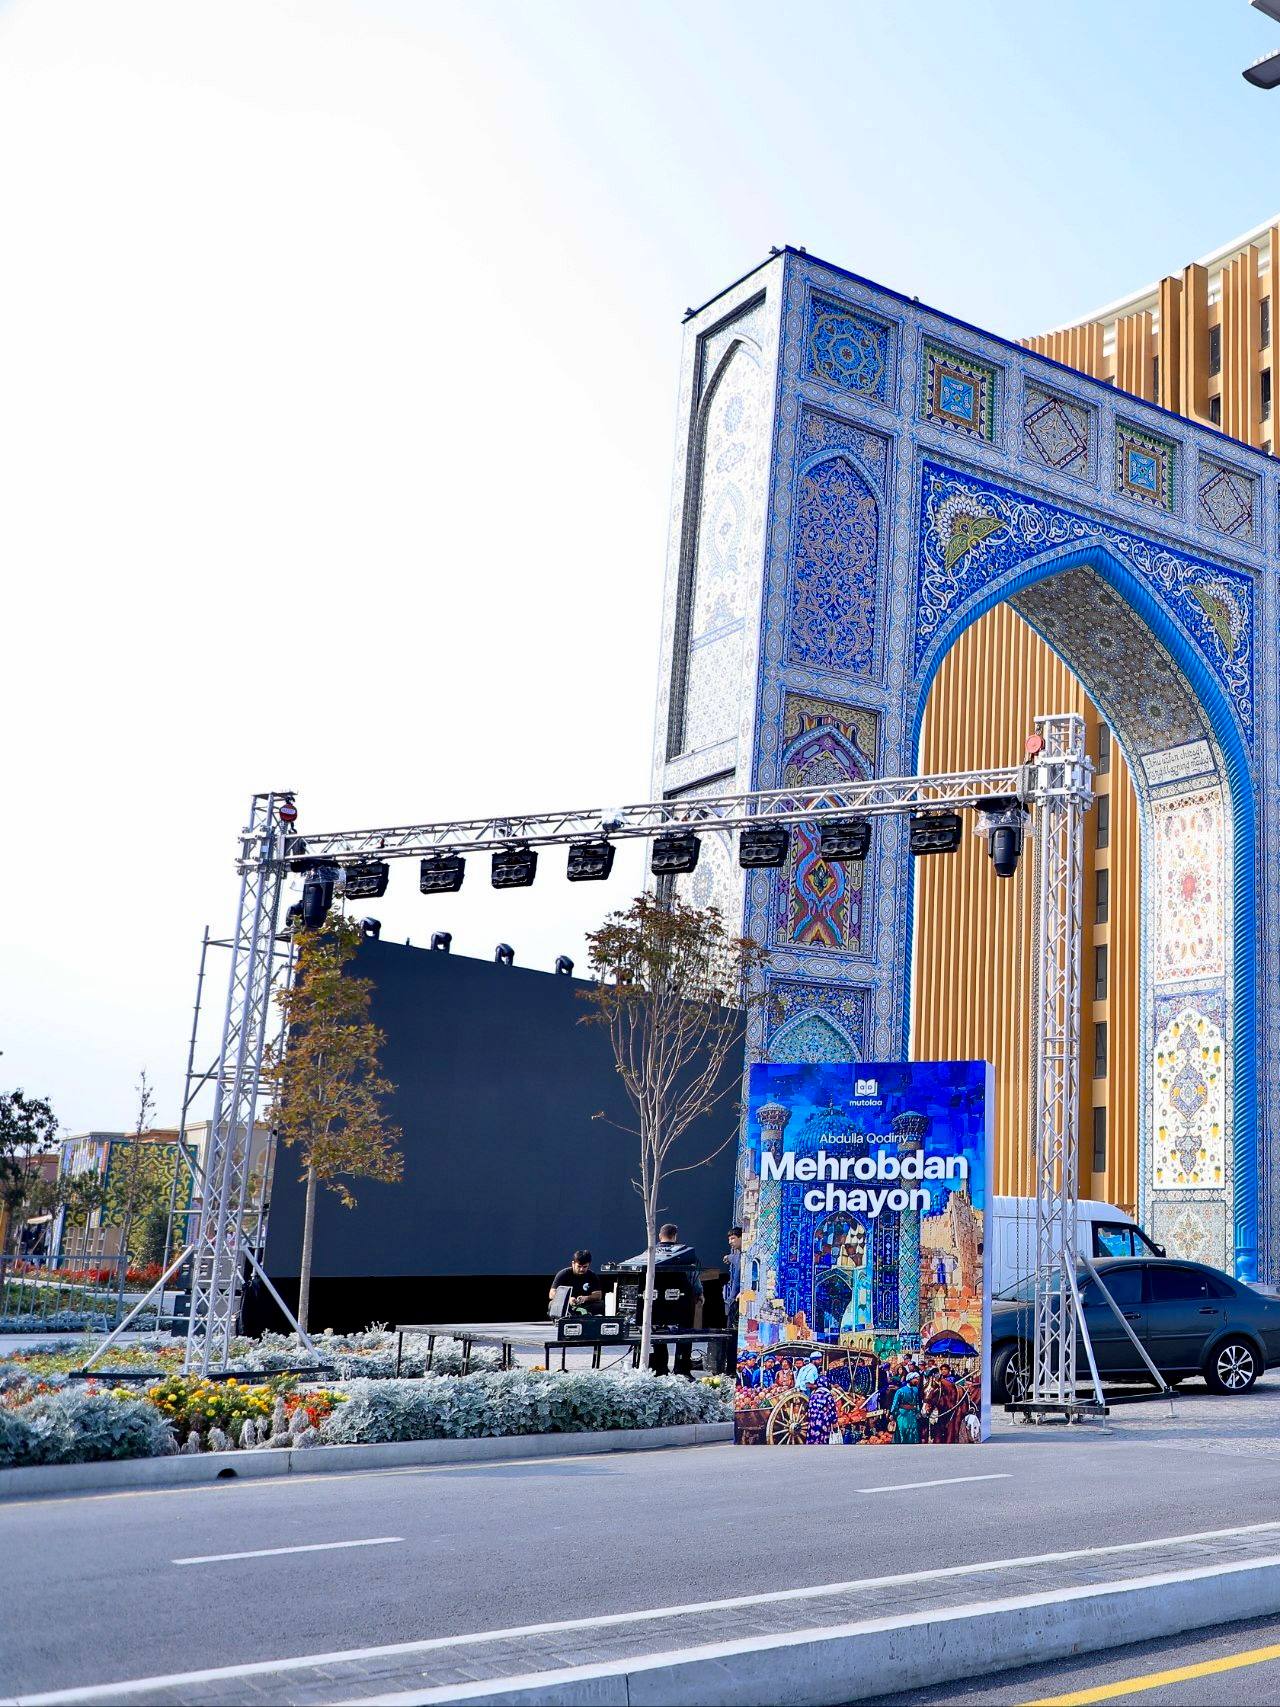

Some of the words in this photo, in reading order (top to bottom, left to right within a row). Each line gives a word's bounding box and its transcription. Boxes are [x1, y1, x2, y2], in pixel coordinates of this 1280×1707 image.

[819, 1133, 863, 1144] Abdulla
[866, 1133, 908, 1145] Qodiriy
[761, 1150, 968, 1181] Mehrobdan
[804, 1183, 931, 1218] chayon
